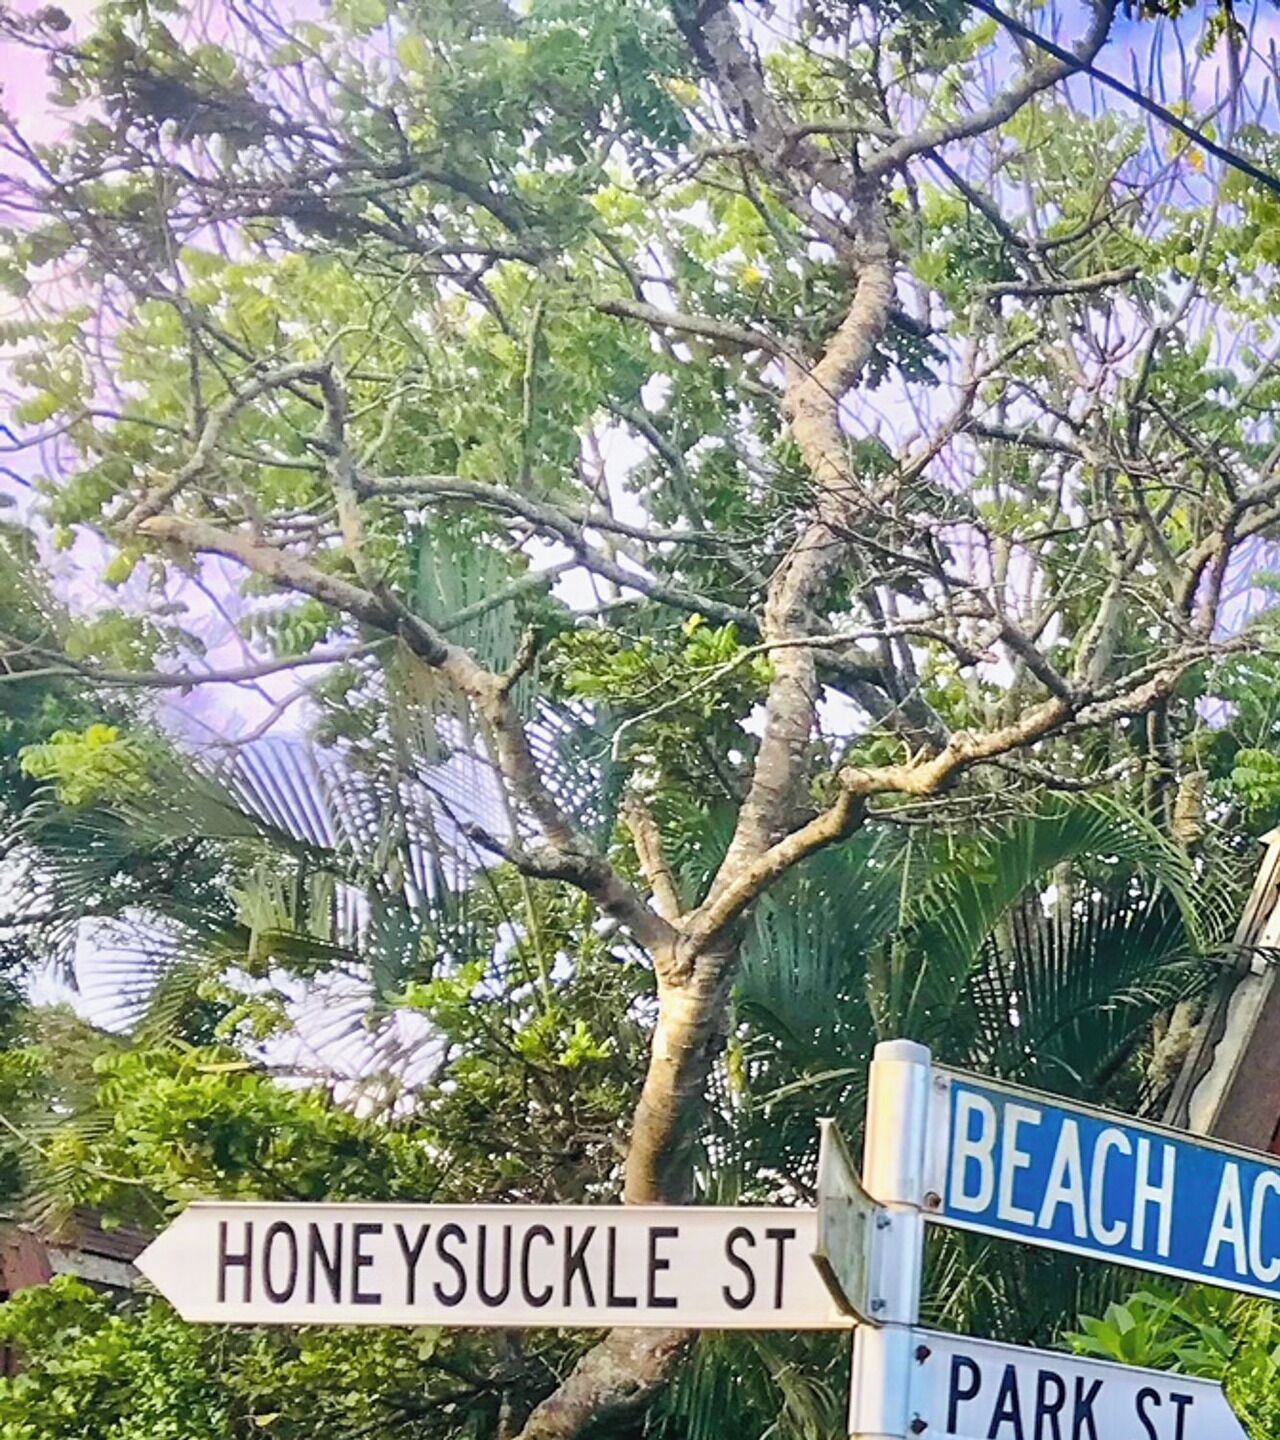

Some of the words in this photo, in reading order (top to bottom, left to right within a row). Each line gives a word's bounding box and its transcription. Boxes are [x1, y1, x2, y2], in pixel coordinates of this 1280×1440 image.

[948, 1090, 1176, 1258] BEACH
[217, 1220, 678, 1308] HONEYSUCKLE
[722, 1227, 797, 1310] ST
